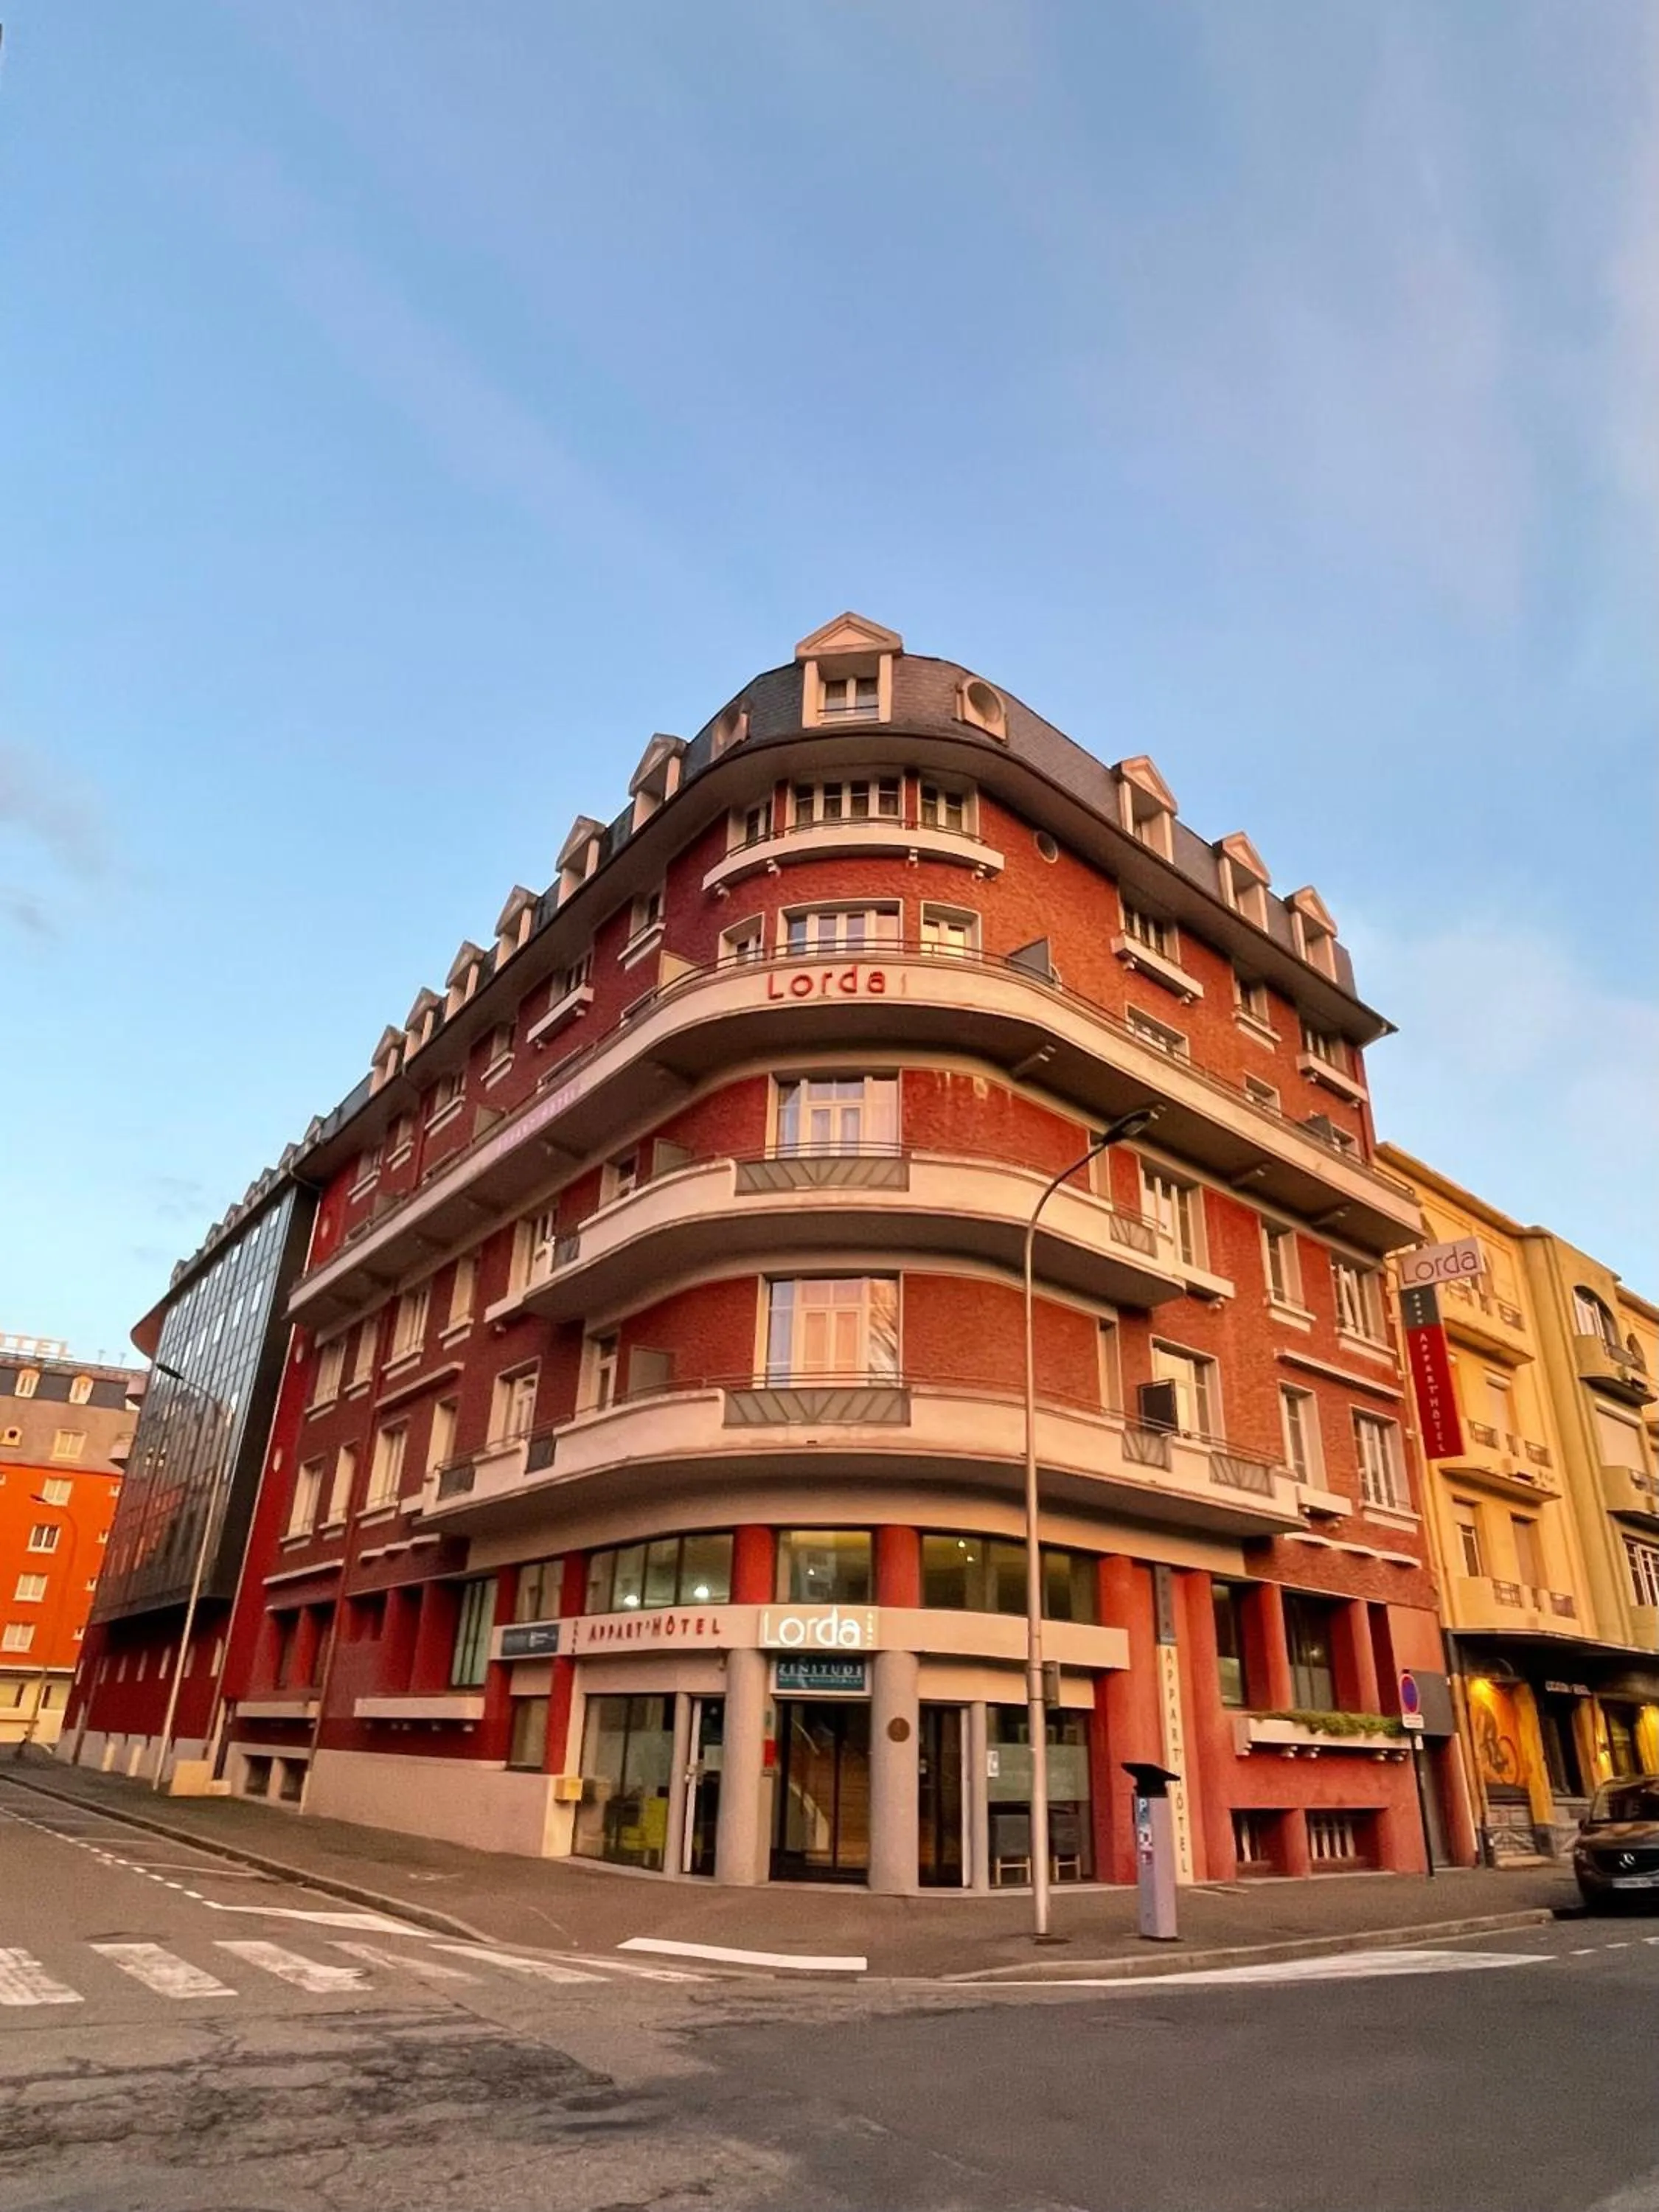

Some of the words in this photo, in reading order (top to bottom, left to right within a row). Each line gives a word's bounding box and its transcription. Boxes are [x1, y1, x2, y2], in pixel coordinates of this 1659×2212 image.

[767, 962, 886, 1000] Lorda
[1400, 1245, 1478, 1284] Lorda
[764, 1605, 860, 1646] Lorda
